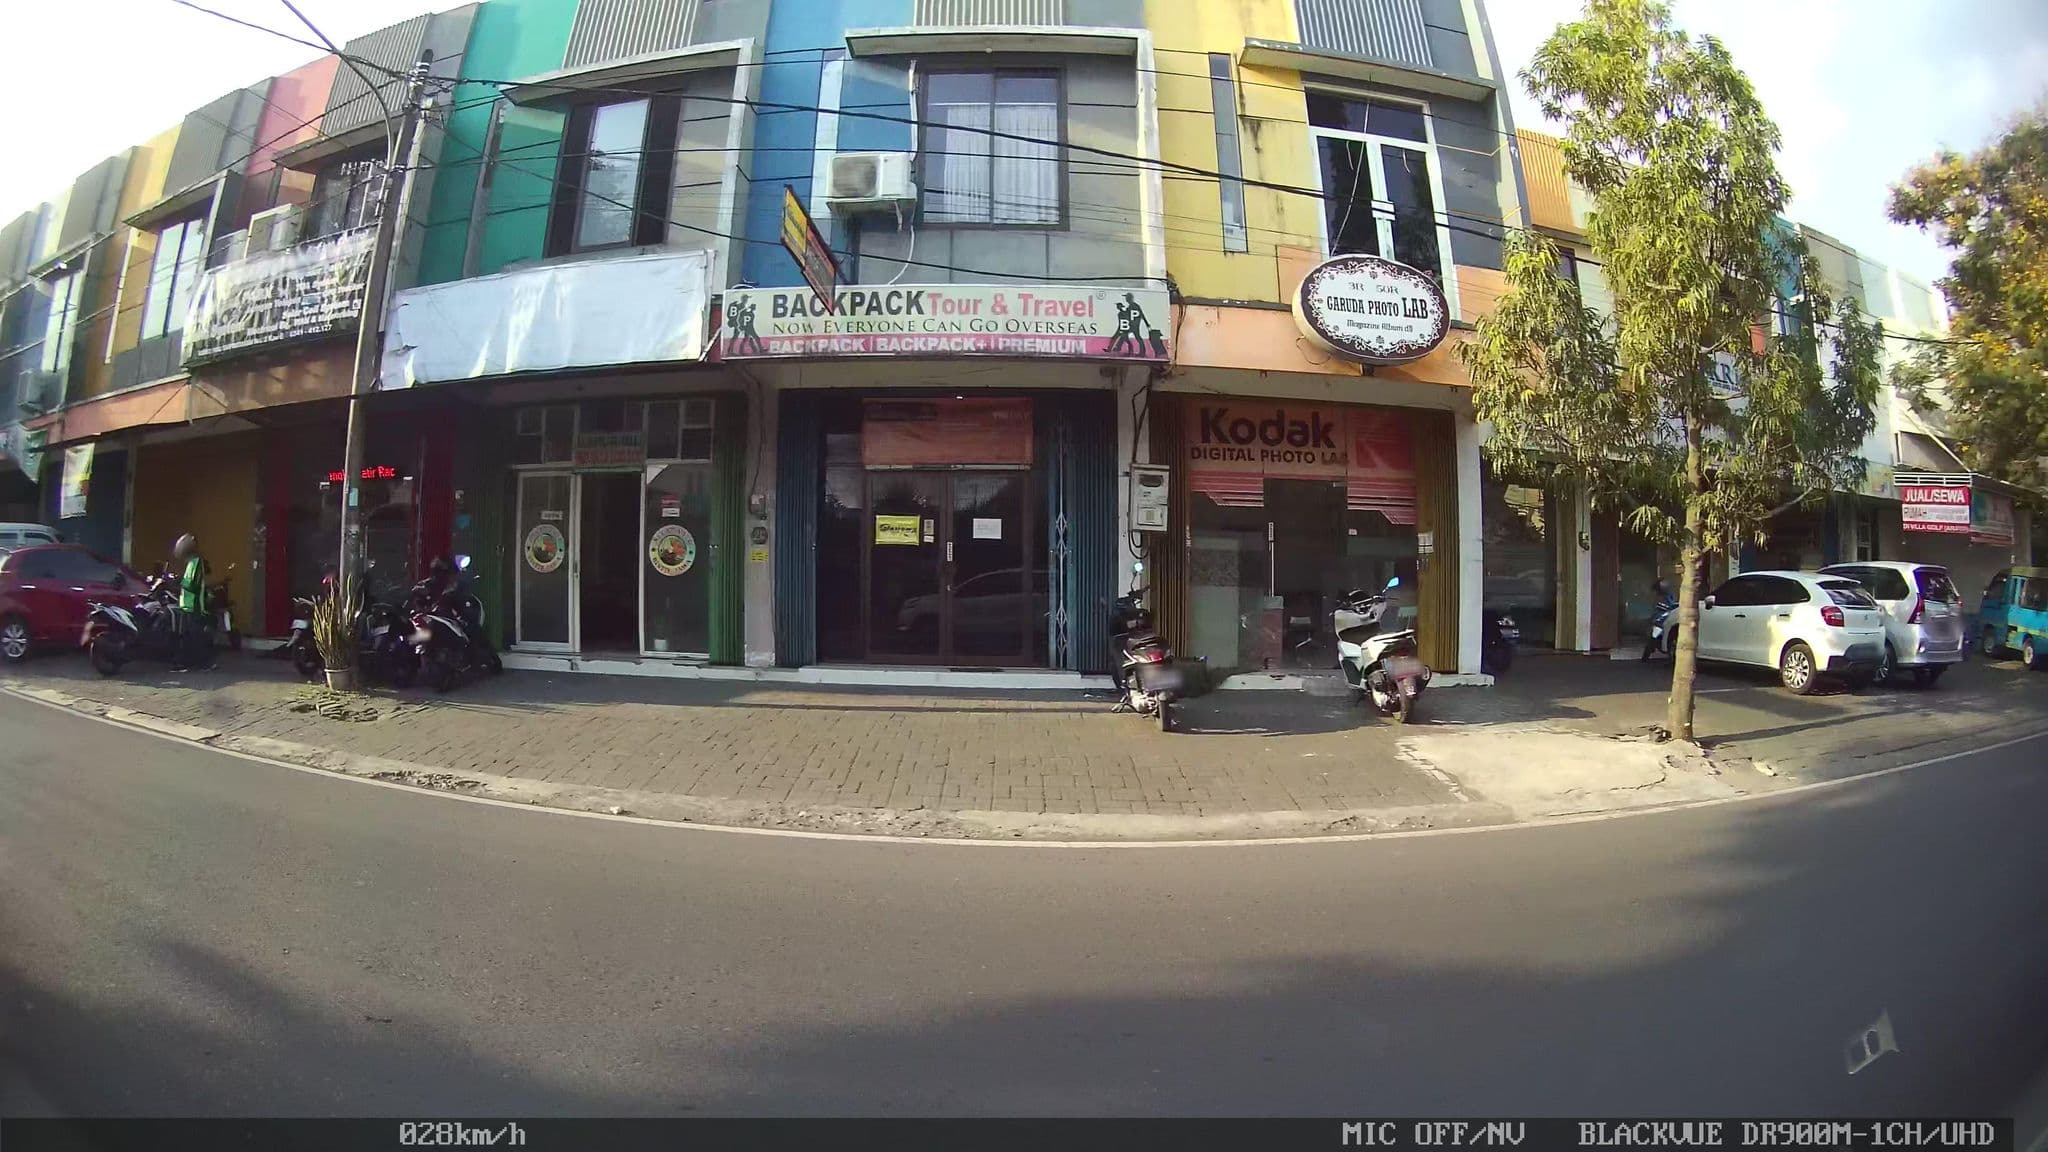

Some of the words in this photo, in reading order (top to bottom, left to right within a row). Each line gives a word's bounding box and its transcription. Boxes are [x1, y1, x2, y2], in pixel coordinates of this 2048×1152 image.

[1347, 281, 1365, 292] 3R
[1376, 284, 1400, 295] 50R
[730, 306, 737, 317] B
[772, 290, 925, 318] BACKPACK
[927, 293, 983, 316] Tour
[990, 292, 1009, 316] &
[1018, 292, 1094, 318] Travel
[1326, 295, 1365, 315] GARUDA
[1368, 300, 1399, 317] PHOTO
[1403, 296, 1429, 319] LAB
[744, 315, 751, 326] P
[1130, 309, 1140, 321] P
[772, 321, 815, 335] NOW
[824, 318, 916, 335] EVERYONE
[923, 317, 962, 333] CAN
[969, 318, 999, 333] GO
[1005, 318, 1098, 335] OVERSEAS
[1119, 319, 1130, 331] B
[768, 337, 866, 354] BACKPACK
[998, 338, 1088, 355] PREMIUM
[1200, 407, 1336, 449] Kodak
[1191, 447, 1255, 463] DIGITAL
[1260, 449, 1316, 465] PHOTO
[1905, 488, 1966, 503] JUAL/SEWA
